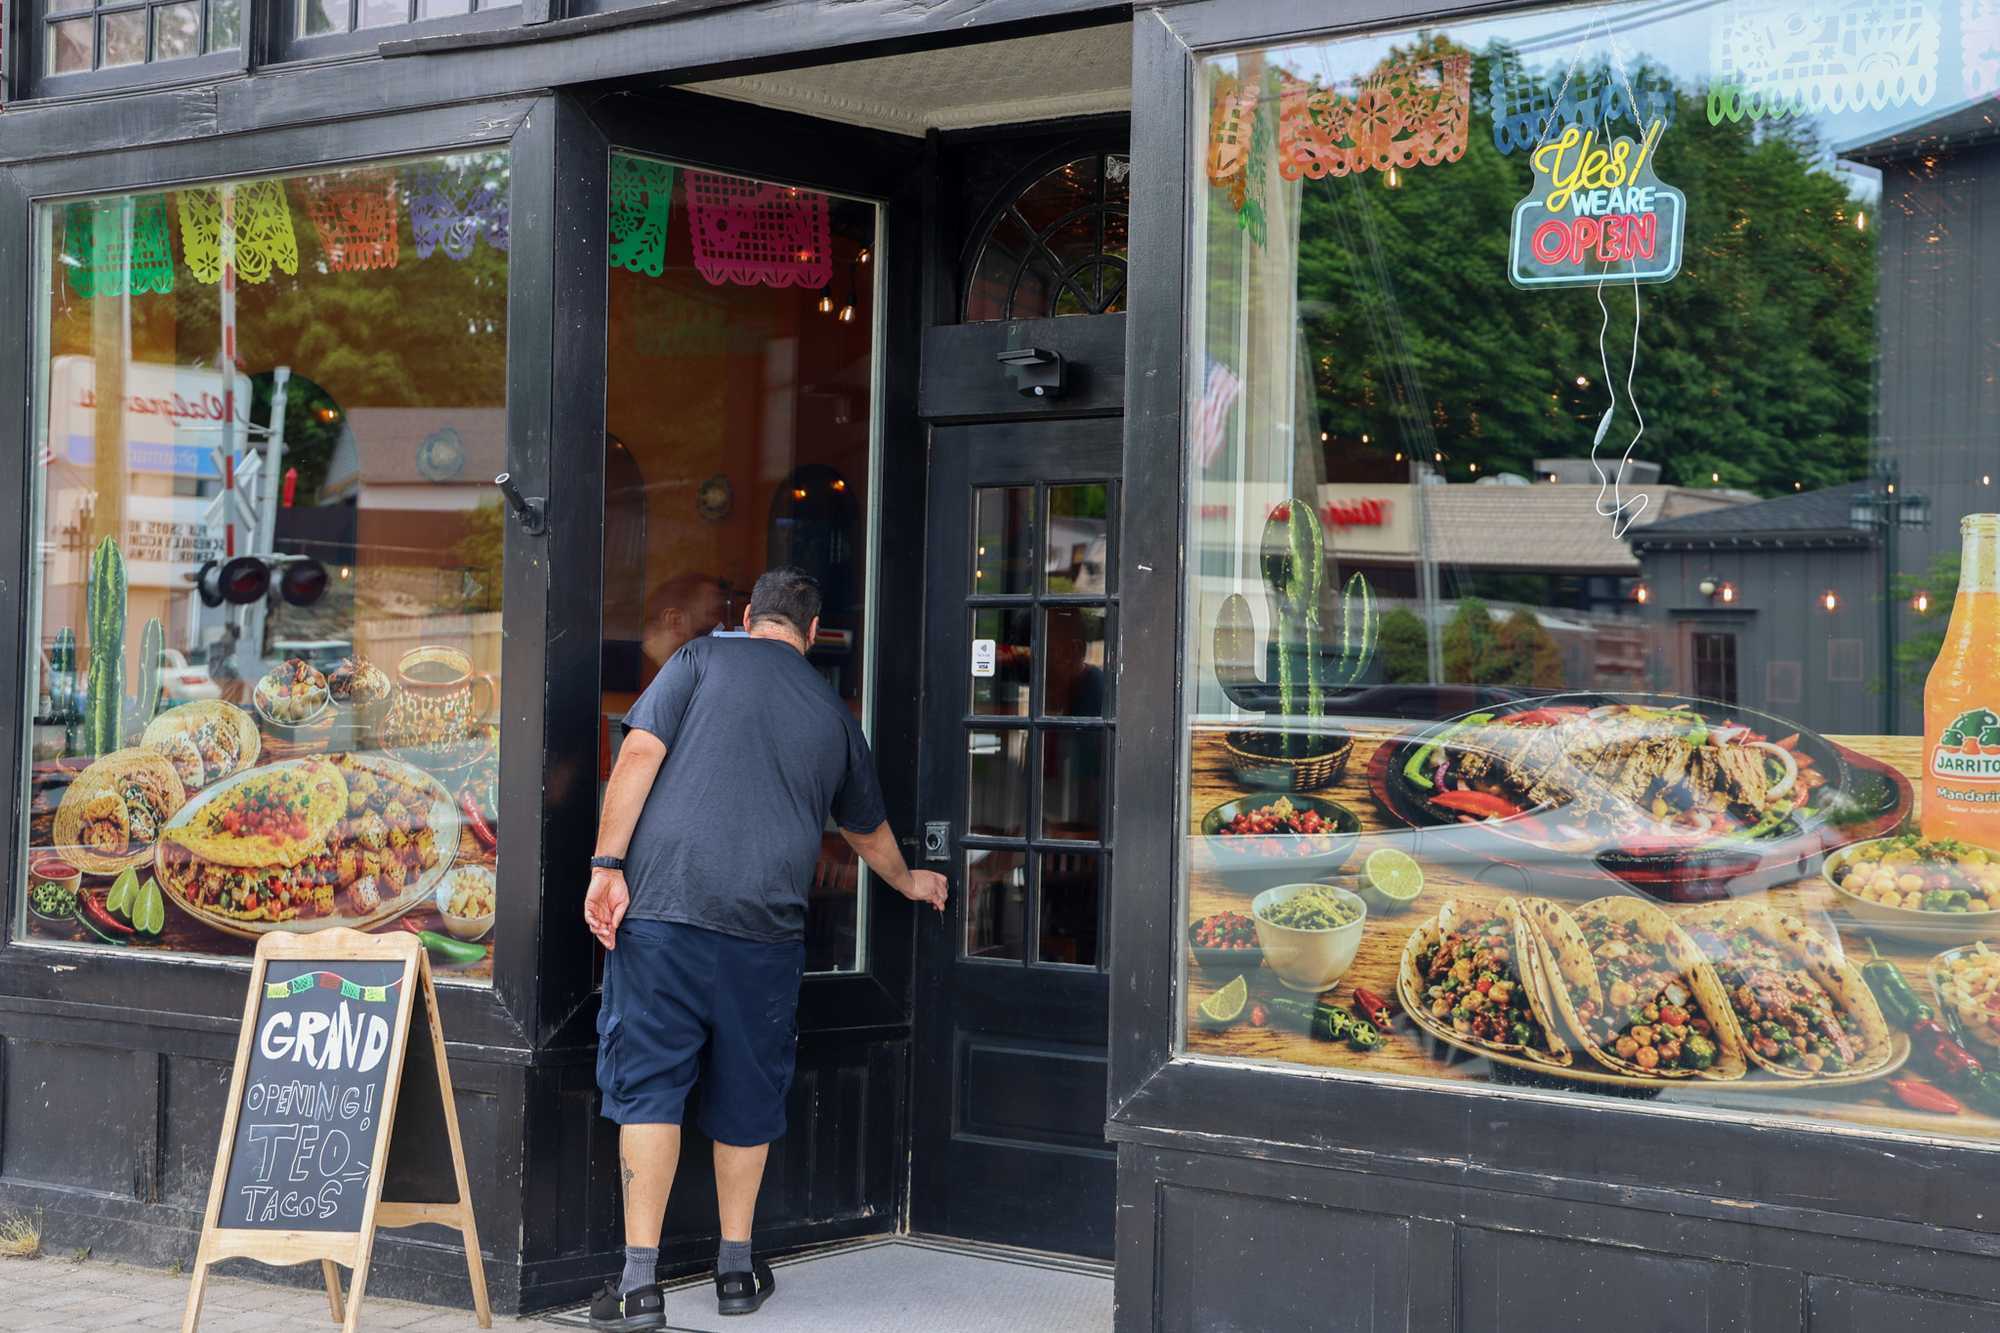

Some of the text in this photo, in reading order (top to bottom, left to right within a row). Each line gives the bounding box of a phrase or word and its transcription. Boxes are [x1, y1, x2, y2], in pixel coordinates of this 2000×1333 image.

[1534, 120, 1661, 213] Yes!
[1532, 212, 1657, 265] OPEN
[260, 1000, 389, 1073] GRAND
[247, 1079, 375, 1132] OPENING!
[248, 1123, 351, 1183] TEO
[241, 1179, 343, 1222] TACOS
